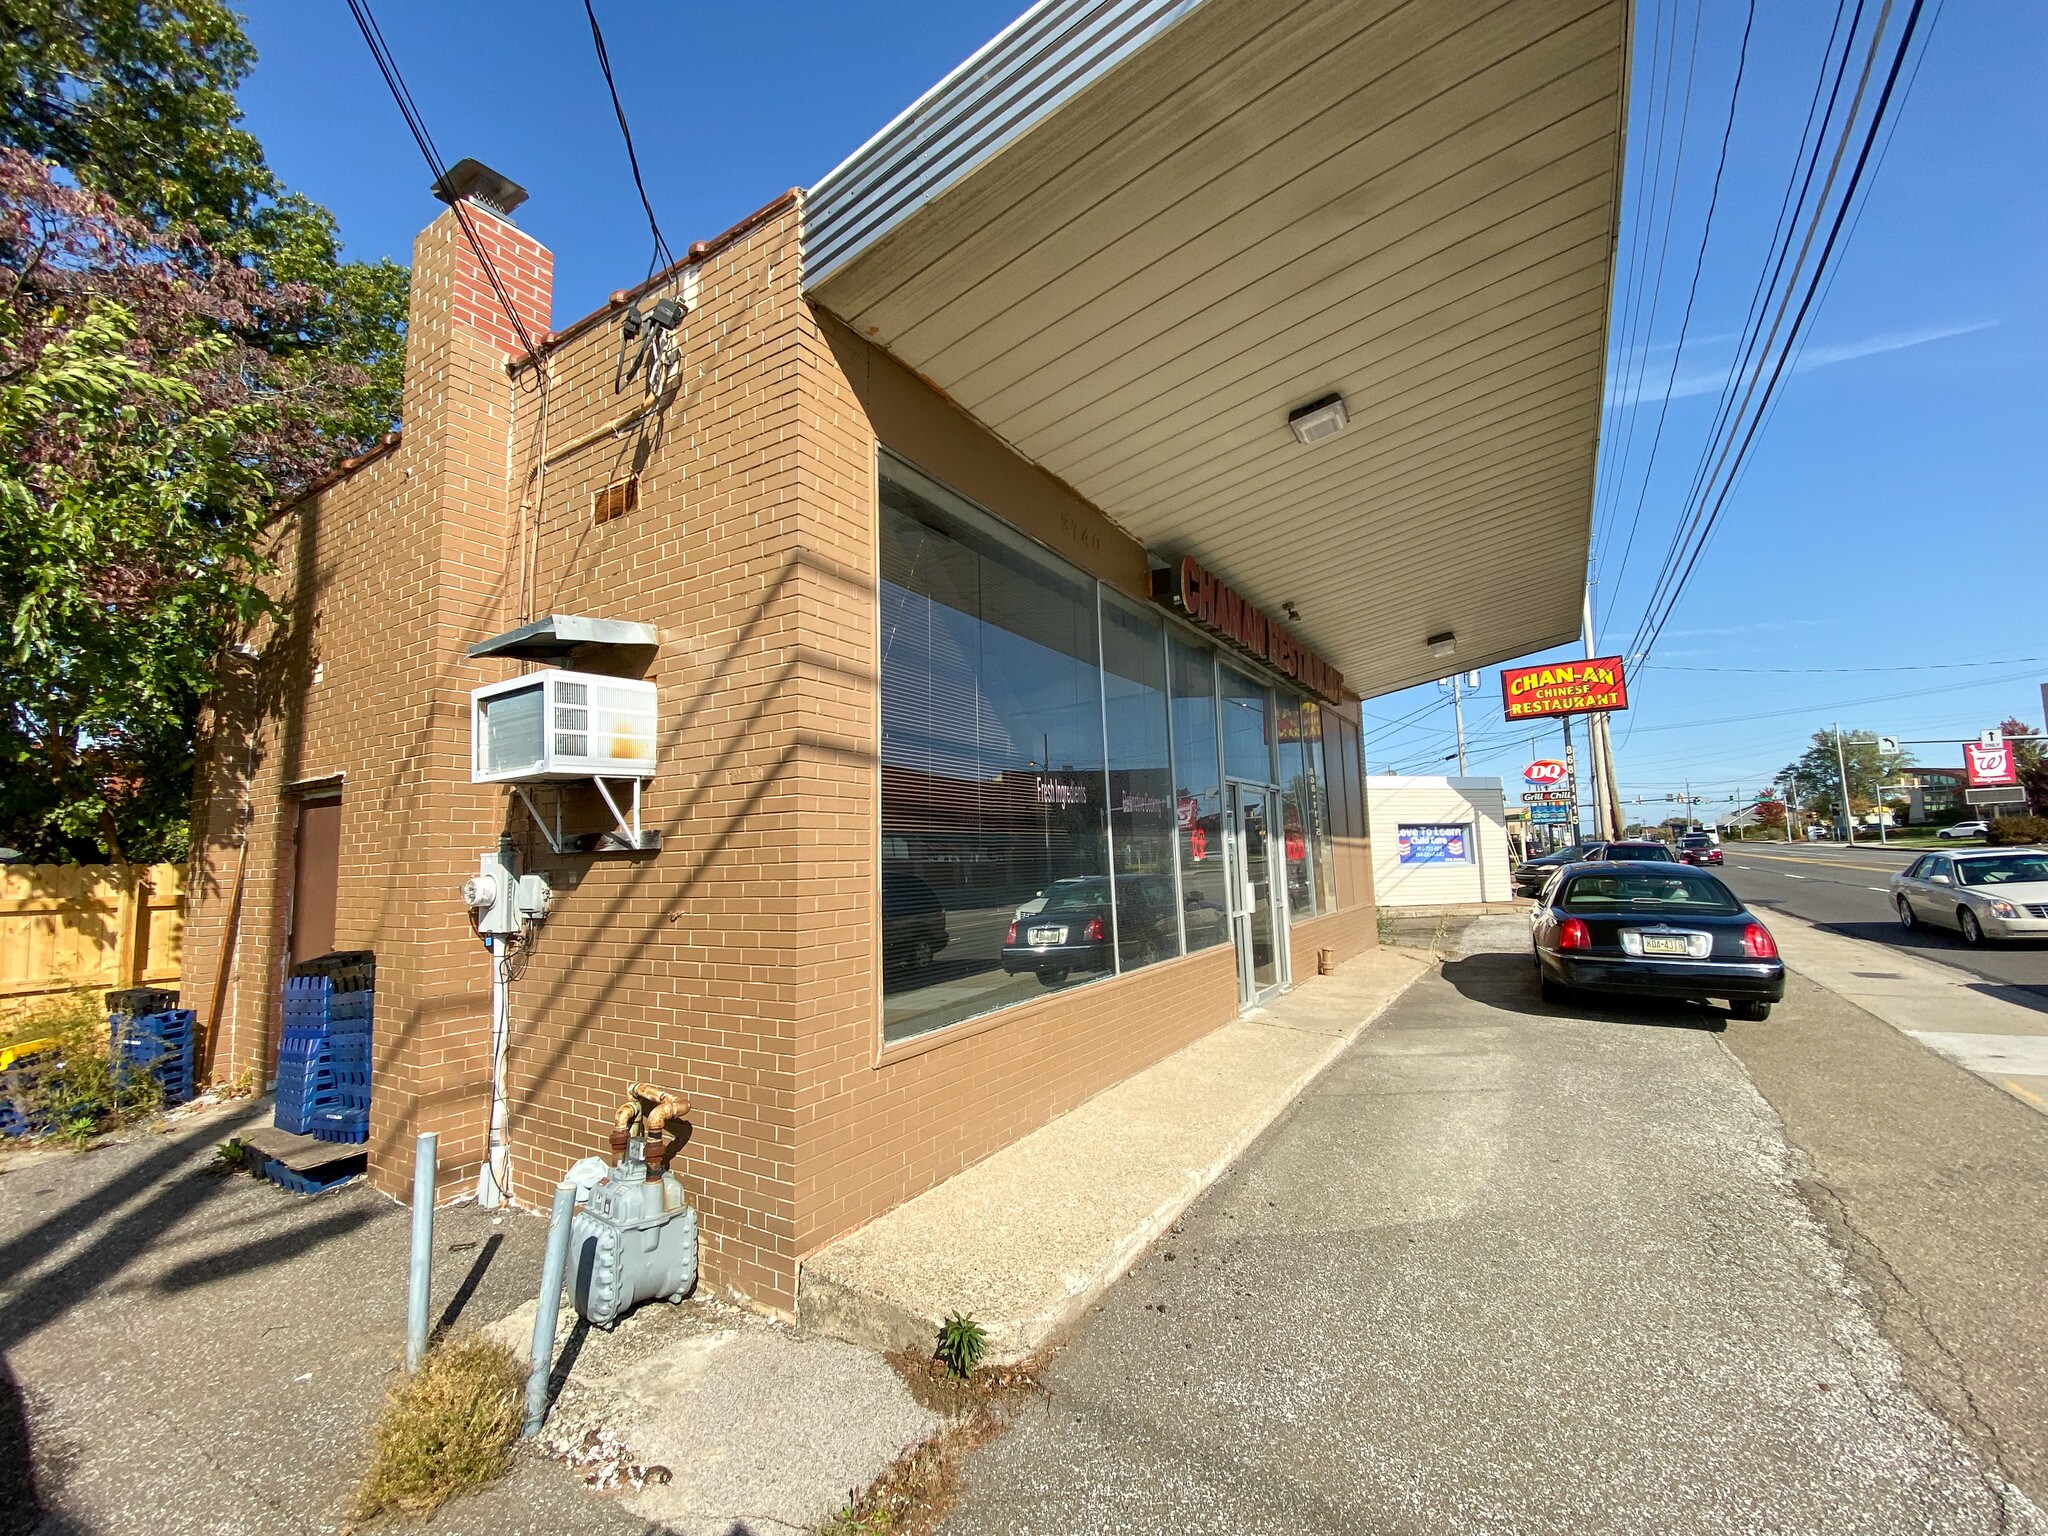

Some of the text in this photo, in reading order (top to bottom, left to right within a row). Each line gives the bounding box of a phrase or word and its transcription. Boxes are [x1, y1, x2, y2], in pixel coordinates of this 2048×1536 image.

[1510, 666, 1615, 696] CHAN-AN
[1536, 684, 1590, 699] CHINESE
[1511, 692, 1618, 715] RESTAURANT
[1530, 764, 1561, 779] DQ
[1036, 777, 1056, 803] Fresh
[1524, 792, 1544, 801] Grill
[1550, 791, 1571, 800] Chill
[1420, 827, 1433, 837] To
[1434, 827, 1462, 837] Learn
[1411, 836, 1430, 845] Child
